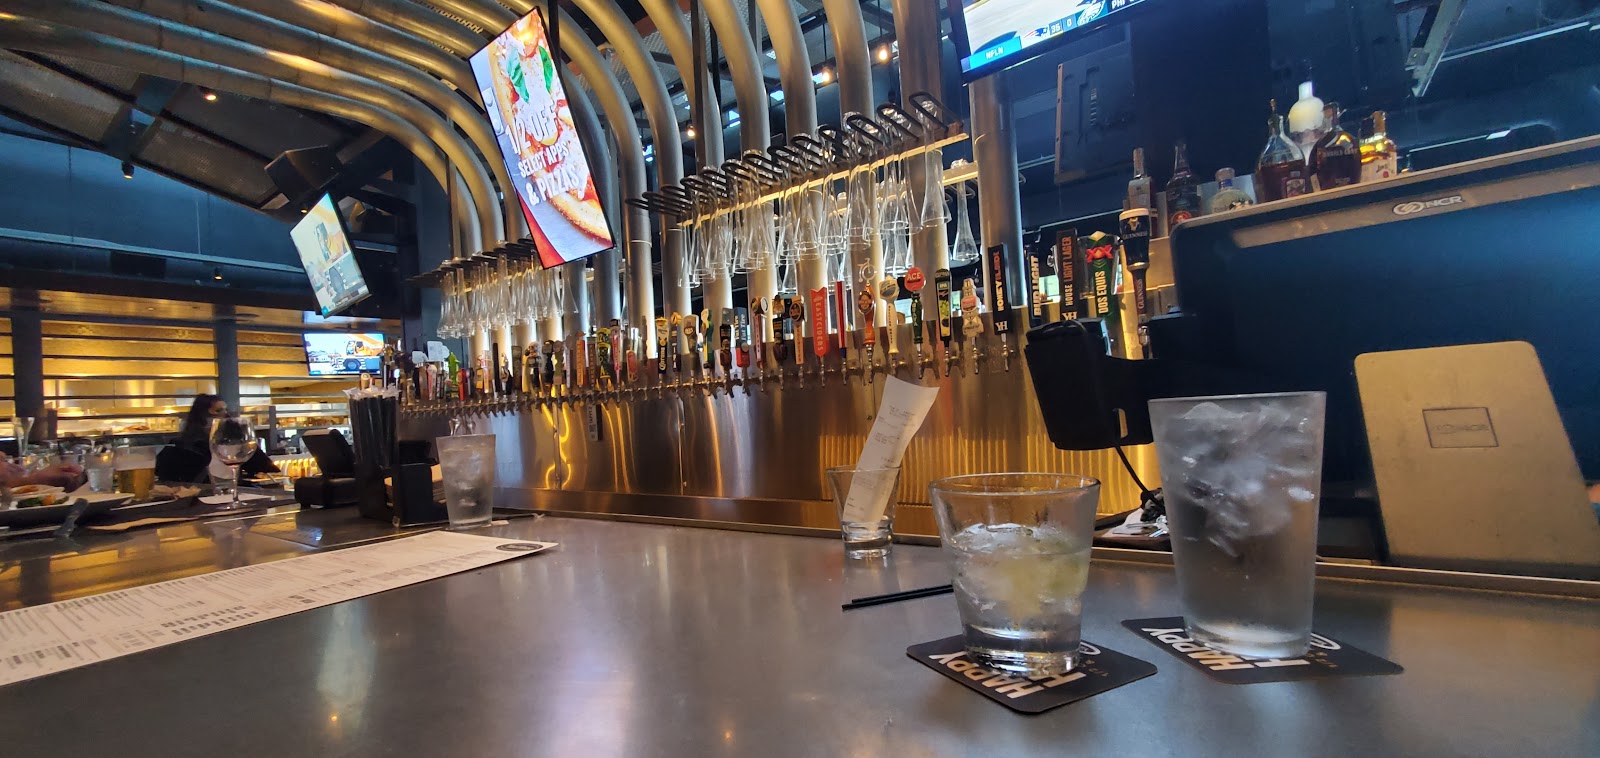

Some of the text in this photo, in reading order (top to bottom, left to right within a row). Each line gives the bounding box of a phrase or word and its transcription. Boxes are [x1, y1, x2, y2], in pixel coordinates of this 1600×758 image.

[505, 99, 558, 155] 1/2 OFF
[518, 141, 570, 178] SELECT APPS
[525, 164, 581, 206] & PIZZAS
[1425, 195, 1463, 208] NCR
[907, 272, 921, 281] ACE
[1030, 255, 1042, 316] BUD LIGHT
[1061, 236, 1074, 306] HOUSE LIGHT LAGER
[995, 281, 1005, 312] HONEY
[1095, 270, 1109, 314] DOS EQUIS
[1136, 278, 1145, 310] GUINNESS
[815, 302, 824, 351] EASTCIDERS
[659, 346, 667, 371] Corona
